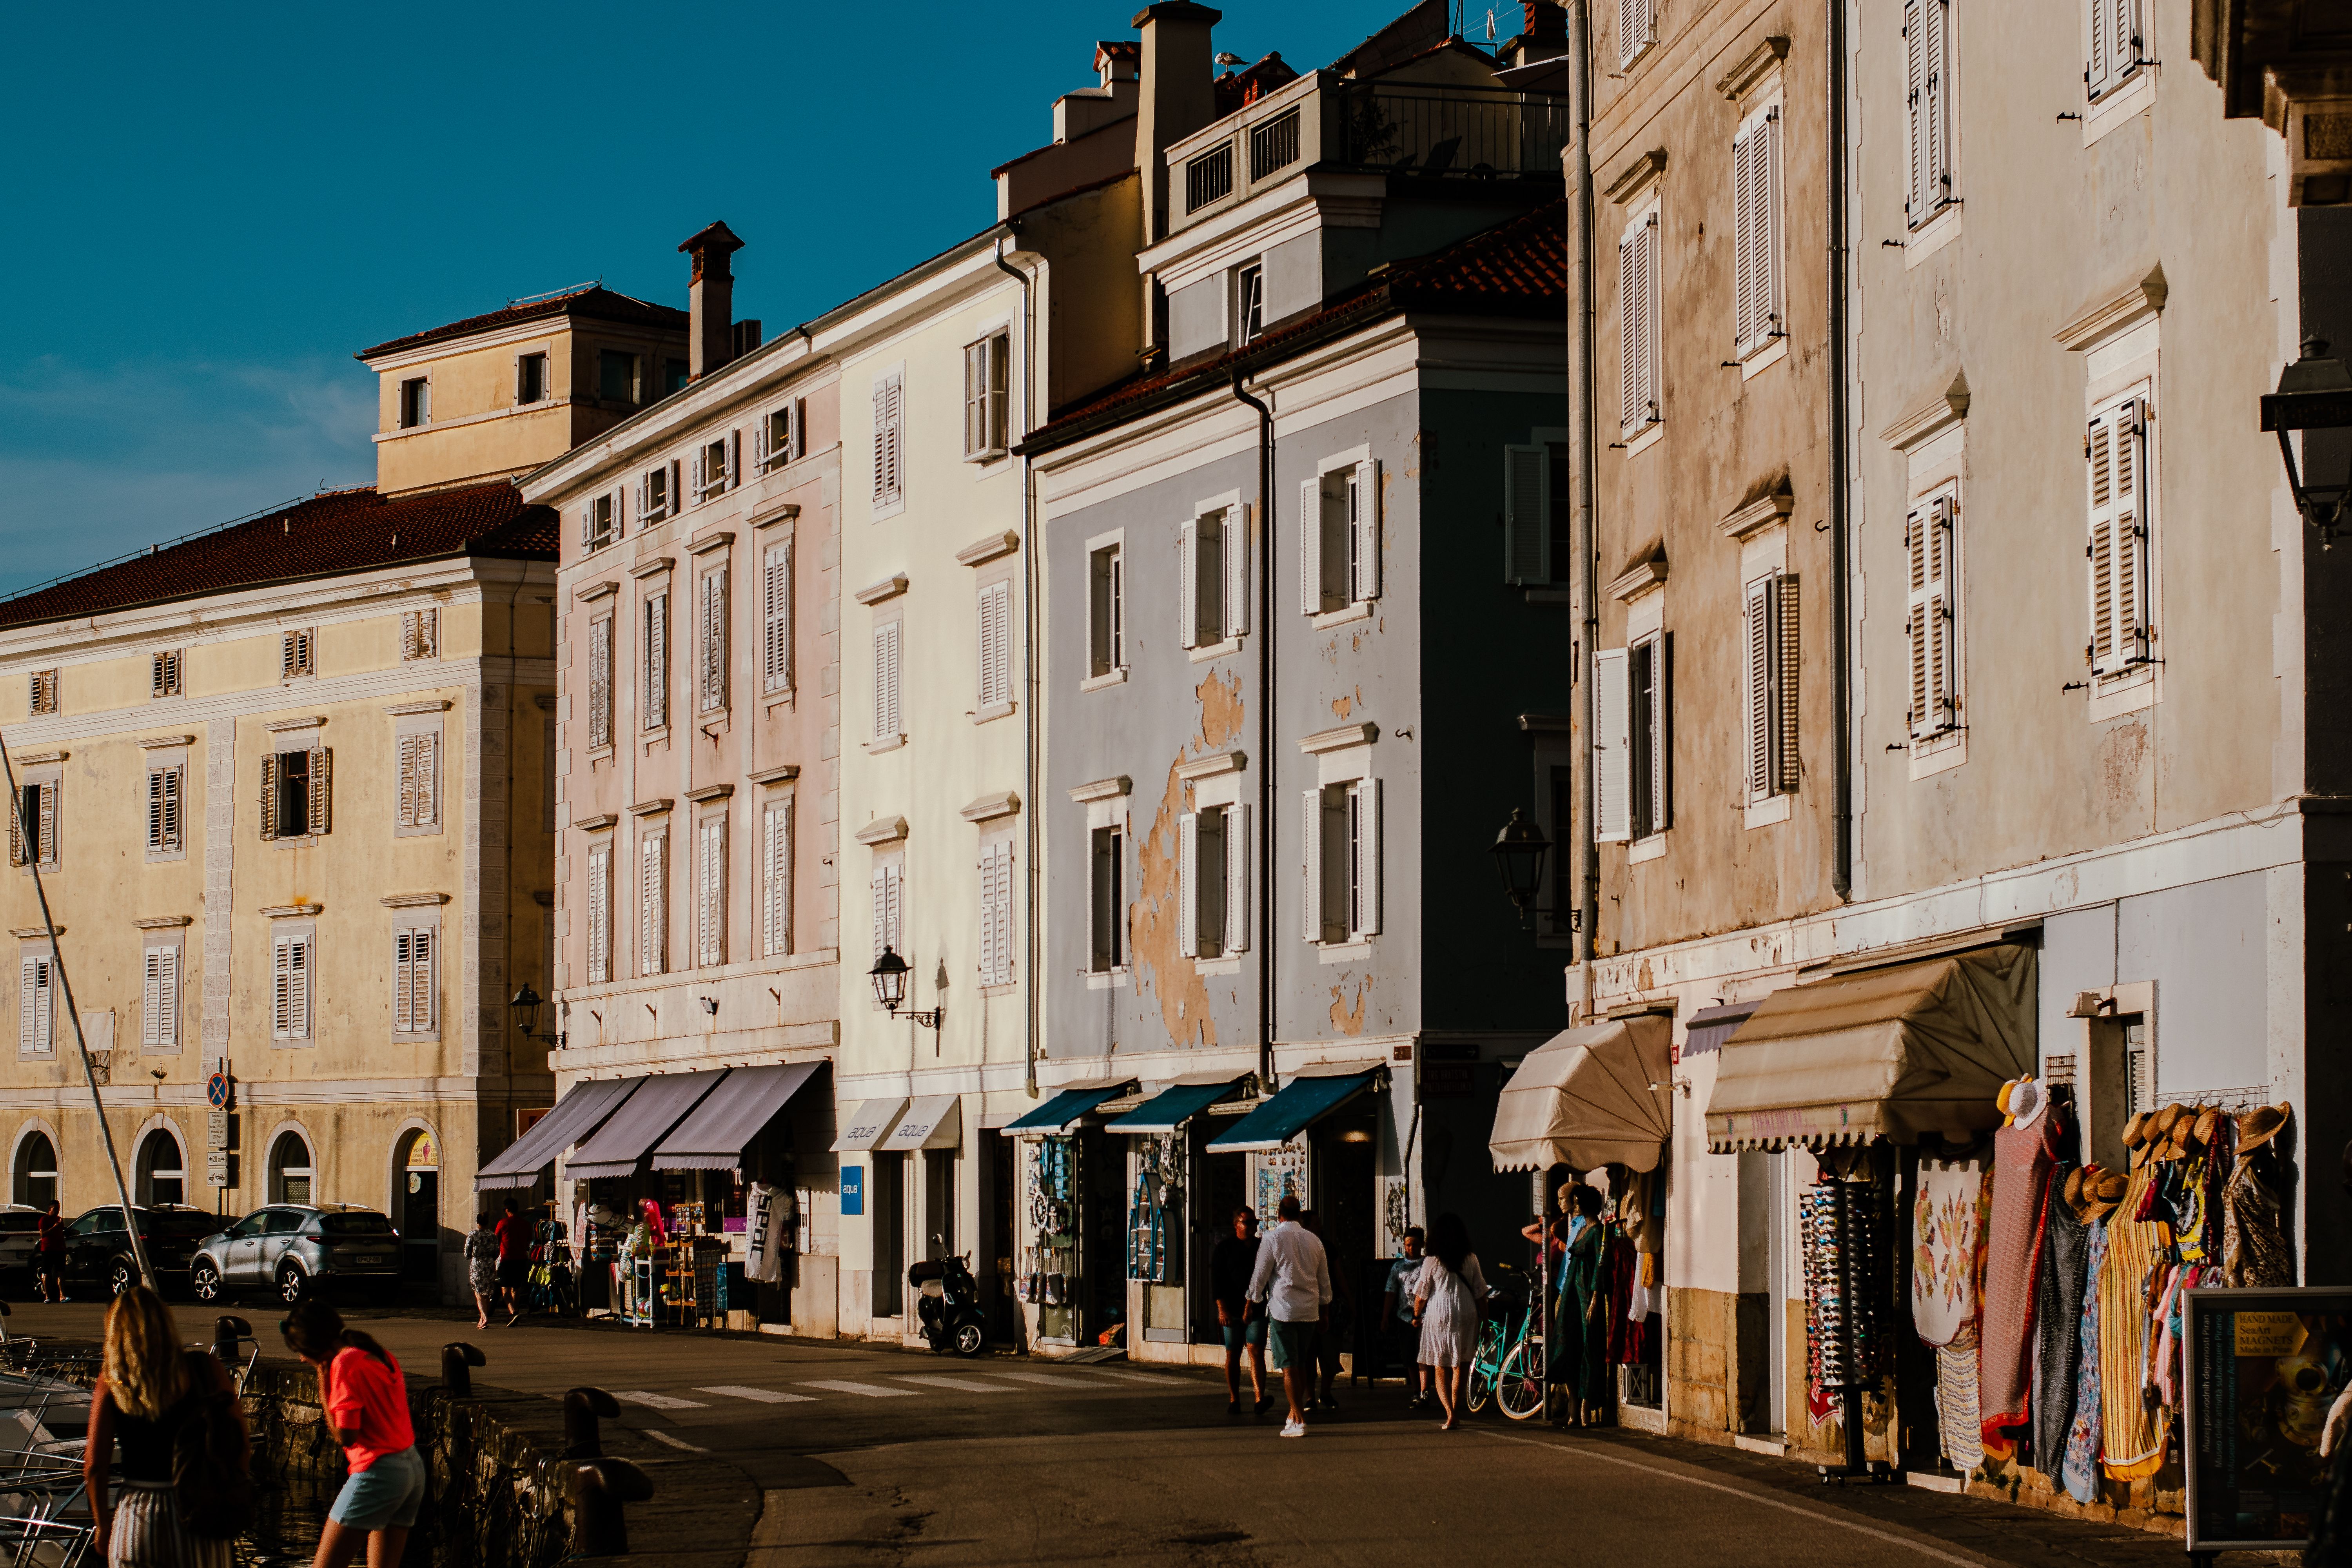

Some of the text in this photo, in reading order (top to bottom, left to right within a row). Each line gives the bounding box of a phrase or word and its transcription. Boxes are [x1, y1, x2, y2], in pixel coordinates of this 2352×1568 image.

[1427, 1069, 1468, 1080] TRG BRATSTVA
[847, 1126, 877, 1141] aqua
[898, 1125, 928, 1140] aqua
[2221, 1144, 2230, 1173] AMERI
[843, 1185, 858, 1195] aqua
[2214, 1314, 2223, 1341] Pirano
[2239, 1314, 2293, 1324] HAND MADE
[2239, 1336, 2293, 1345] MAGNETS
[2215, 1343, 2223, 1387] subacquee
[2202, 1314, 2212, 1452] Muzej podvodnih dejavnosti Piran
[2214, 1389, 2223, 1417] attività
[2227, 1376, 2235, 1425] Underwater
[2214, 1419, 2223, 1439] delle
